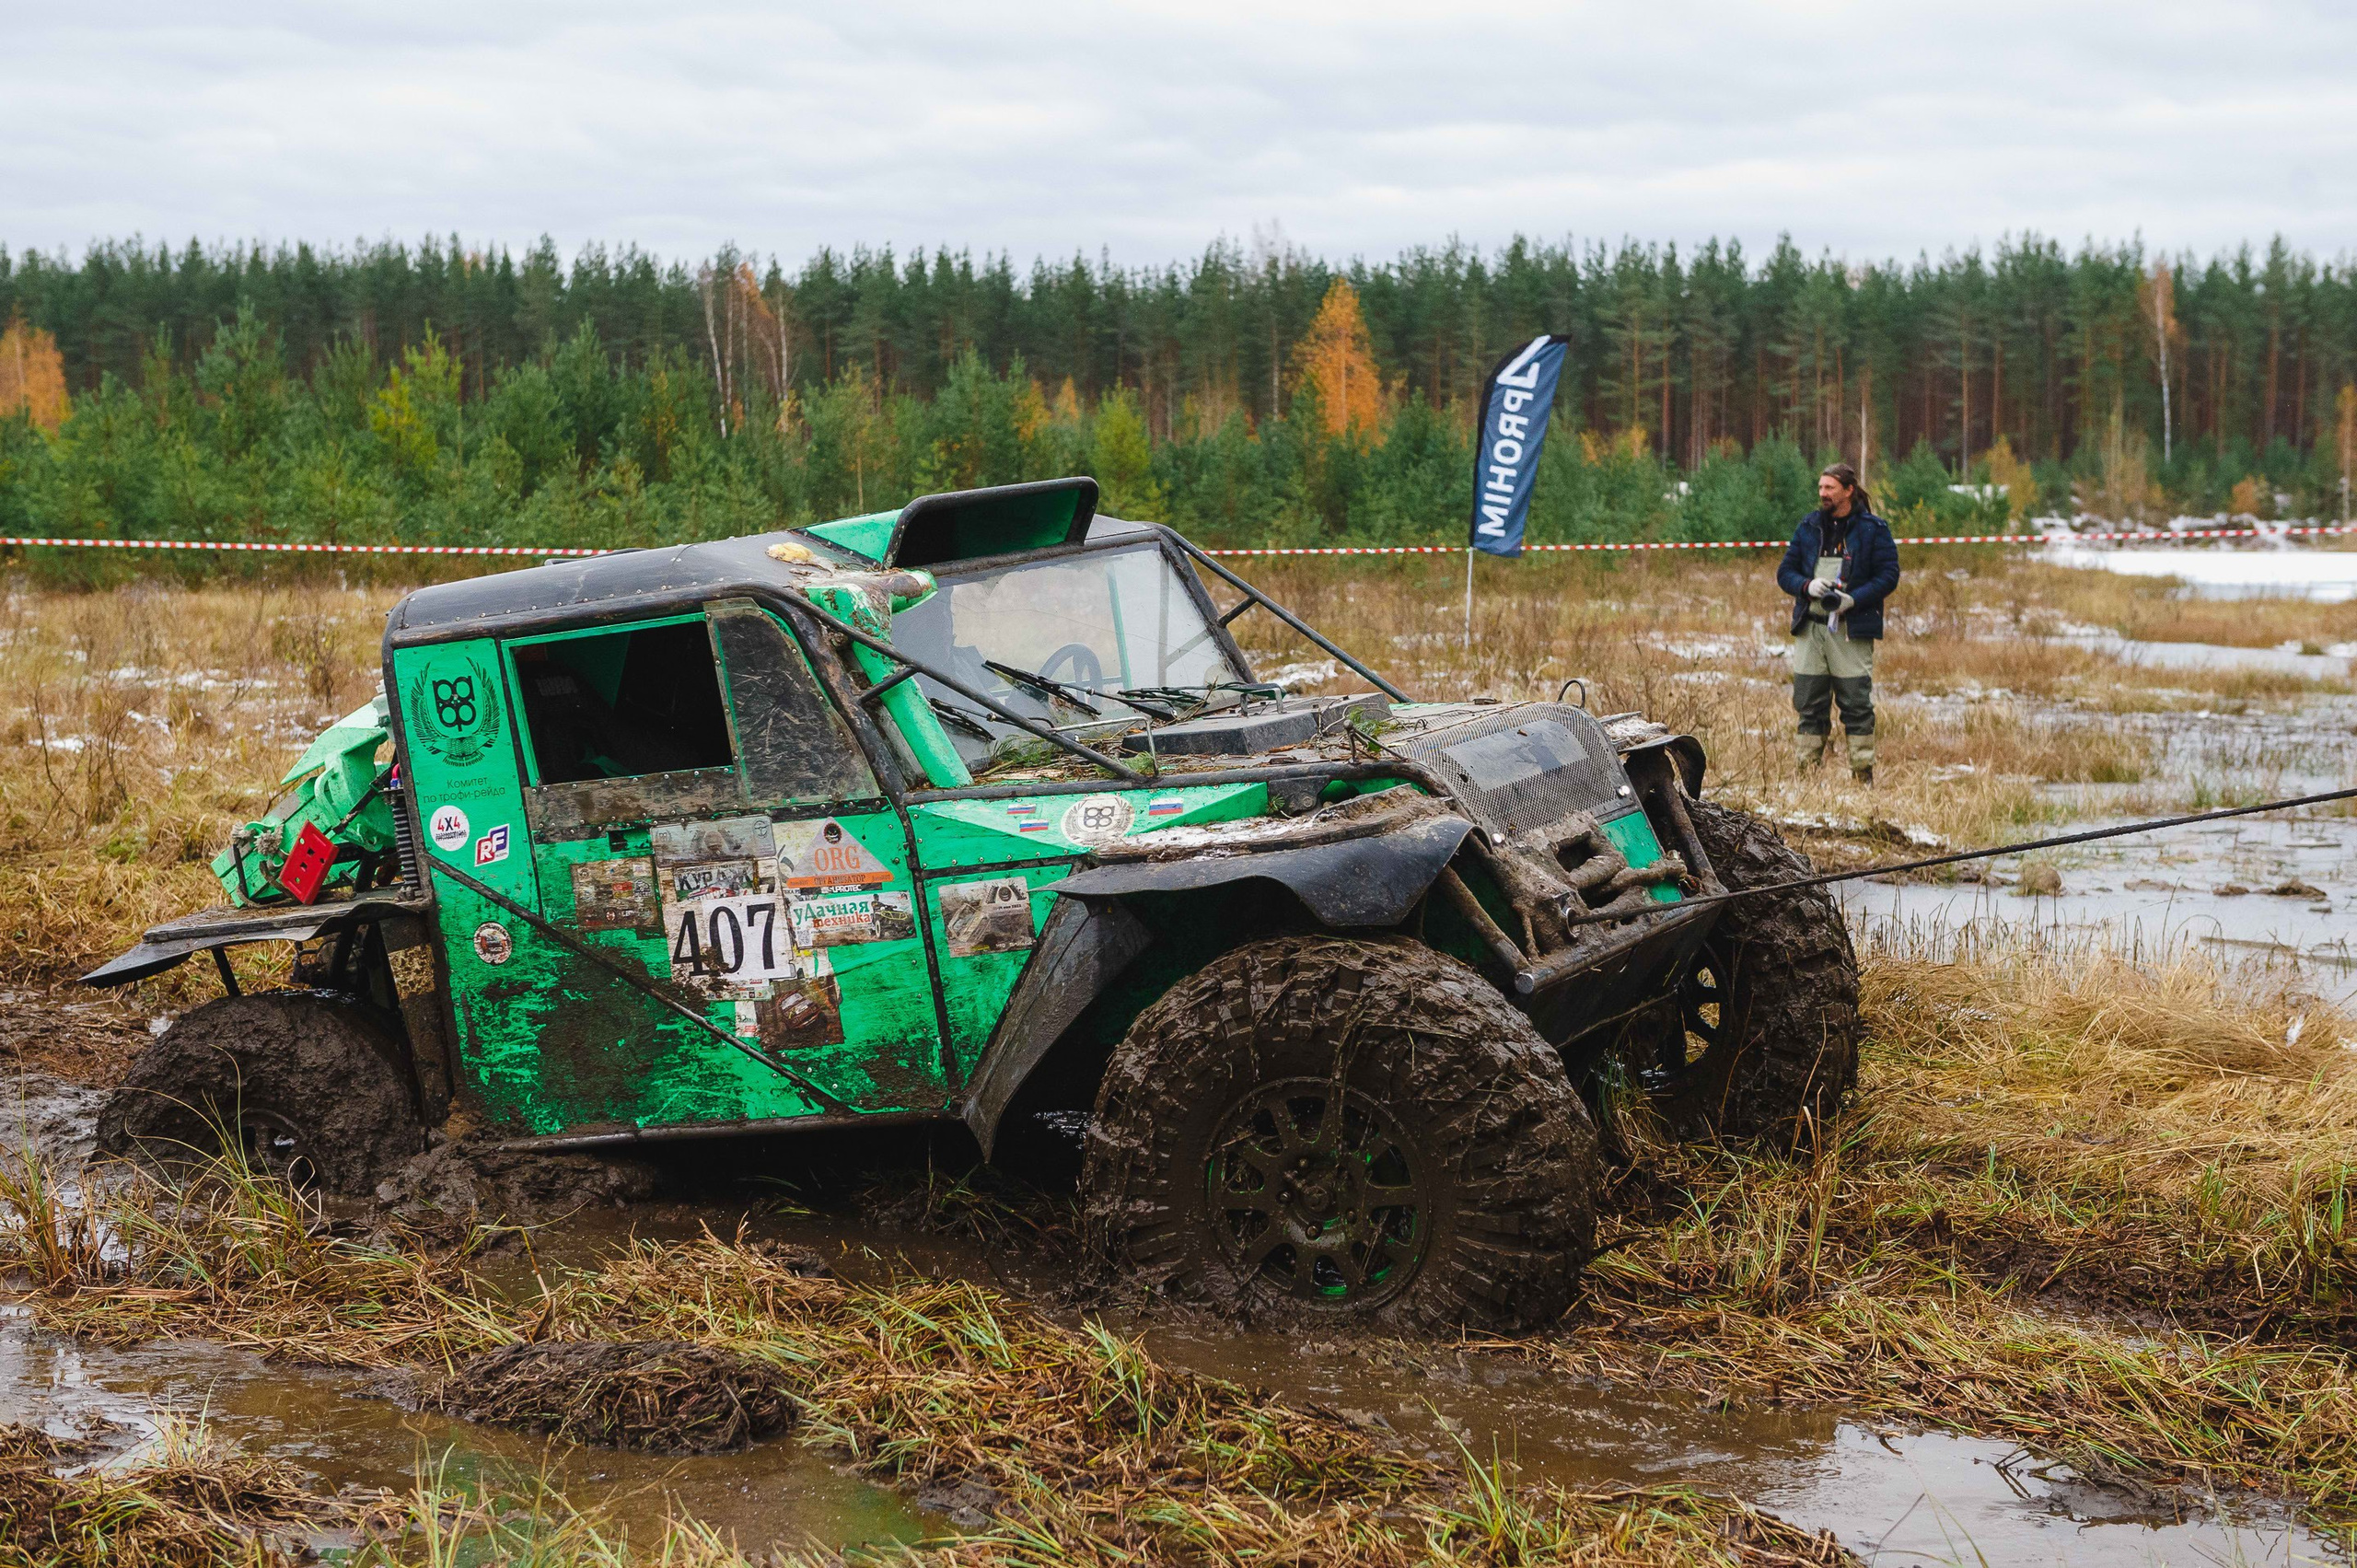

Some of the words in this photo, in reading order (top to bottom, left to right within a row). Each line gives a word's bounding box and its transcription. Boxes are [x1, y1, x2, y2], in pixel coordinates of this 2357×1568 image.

[447, 777, 488, 789] Комитет
[424, 795, 436, 804] по
[439, 786, 505, 803] трофи-рейда
[814, 845, 860, 872] ORG
[813, 874, 866, 885] ОРГАНИЗАТОР
[812, 912, 872, 928] техника
[672, 902, 775, 977] 407
